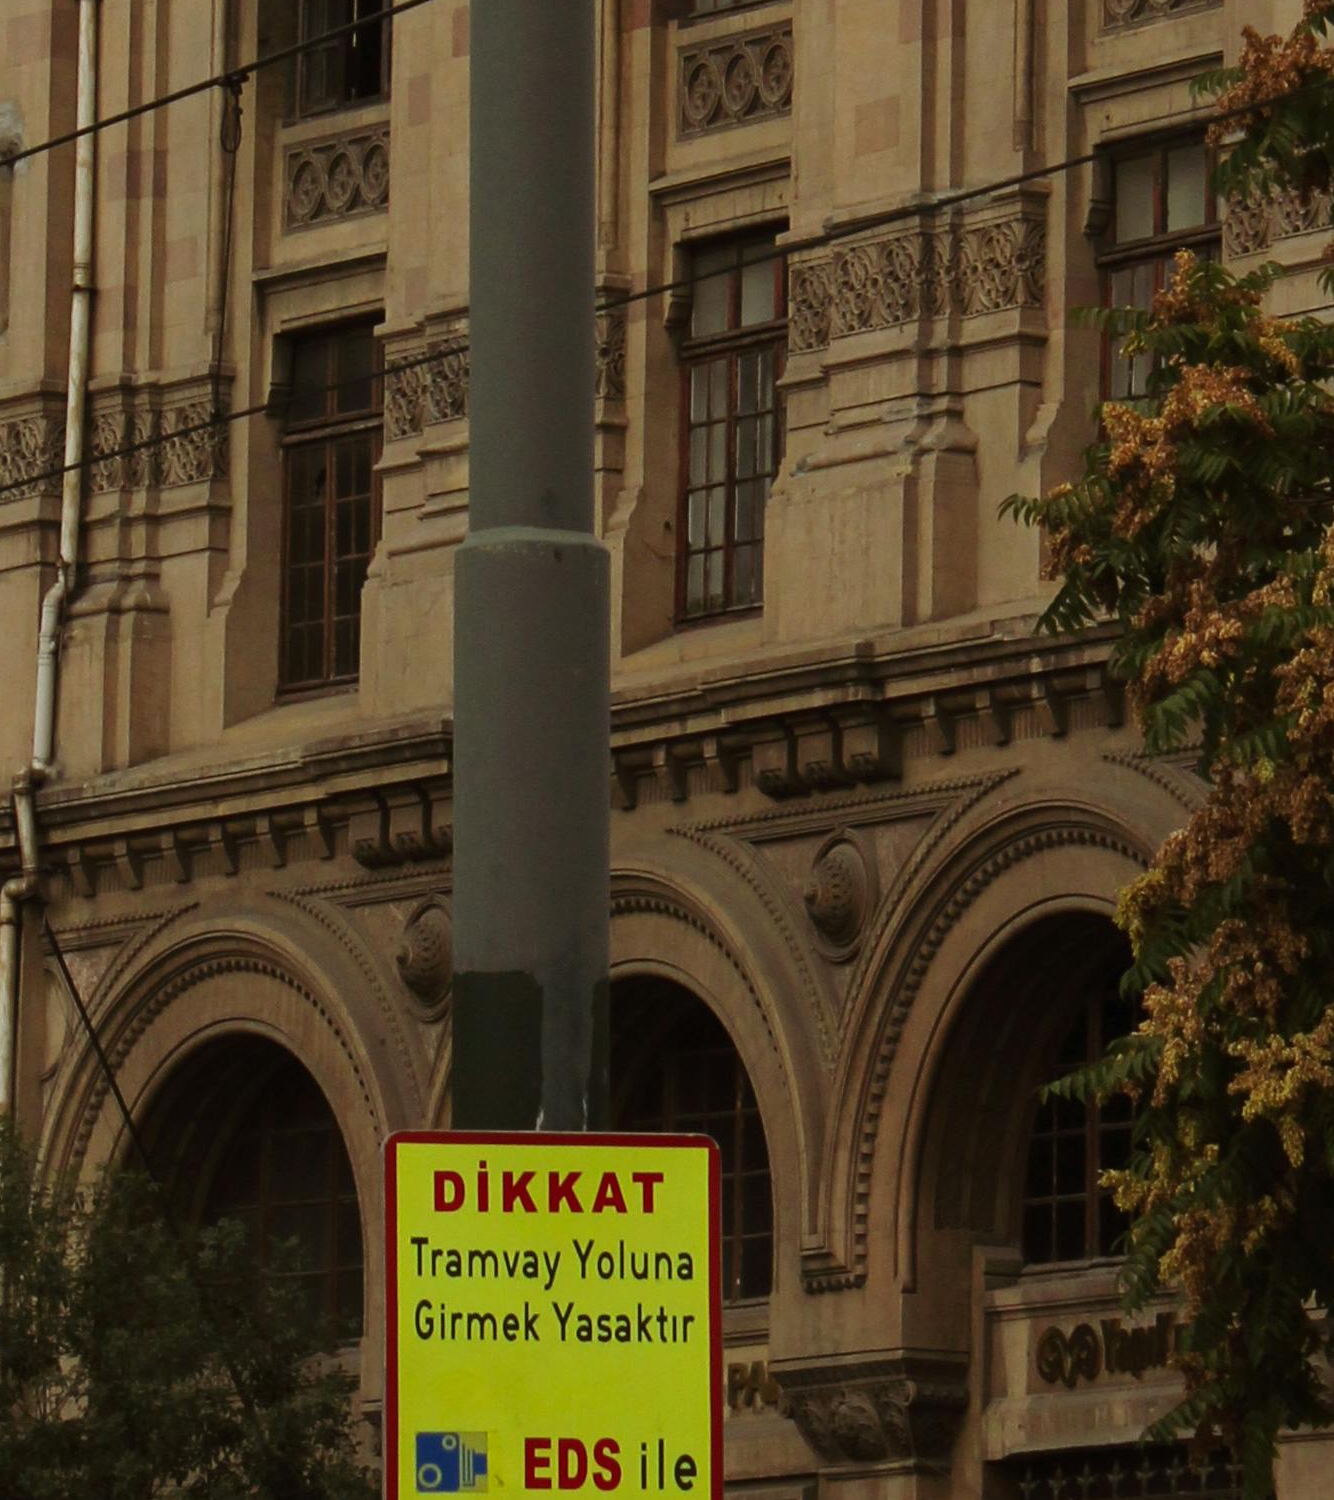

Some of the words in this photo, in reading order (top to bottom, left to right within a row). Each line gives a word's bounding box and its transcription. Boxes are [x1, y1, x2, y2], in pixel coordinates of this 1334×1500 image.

[433, 1160, 664, 1213] DİKKAT
[410, 1237, 560, 1290] Tramvay
[572, 1239, 694, 1280] Yoluna
[415, 1299, 540, 1342] Girmek
[552, 1302, 695, 1343] Yasaktır
[523, 1437, 621, 1490] EDS
[640, 1438, 698, 1490] ile
